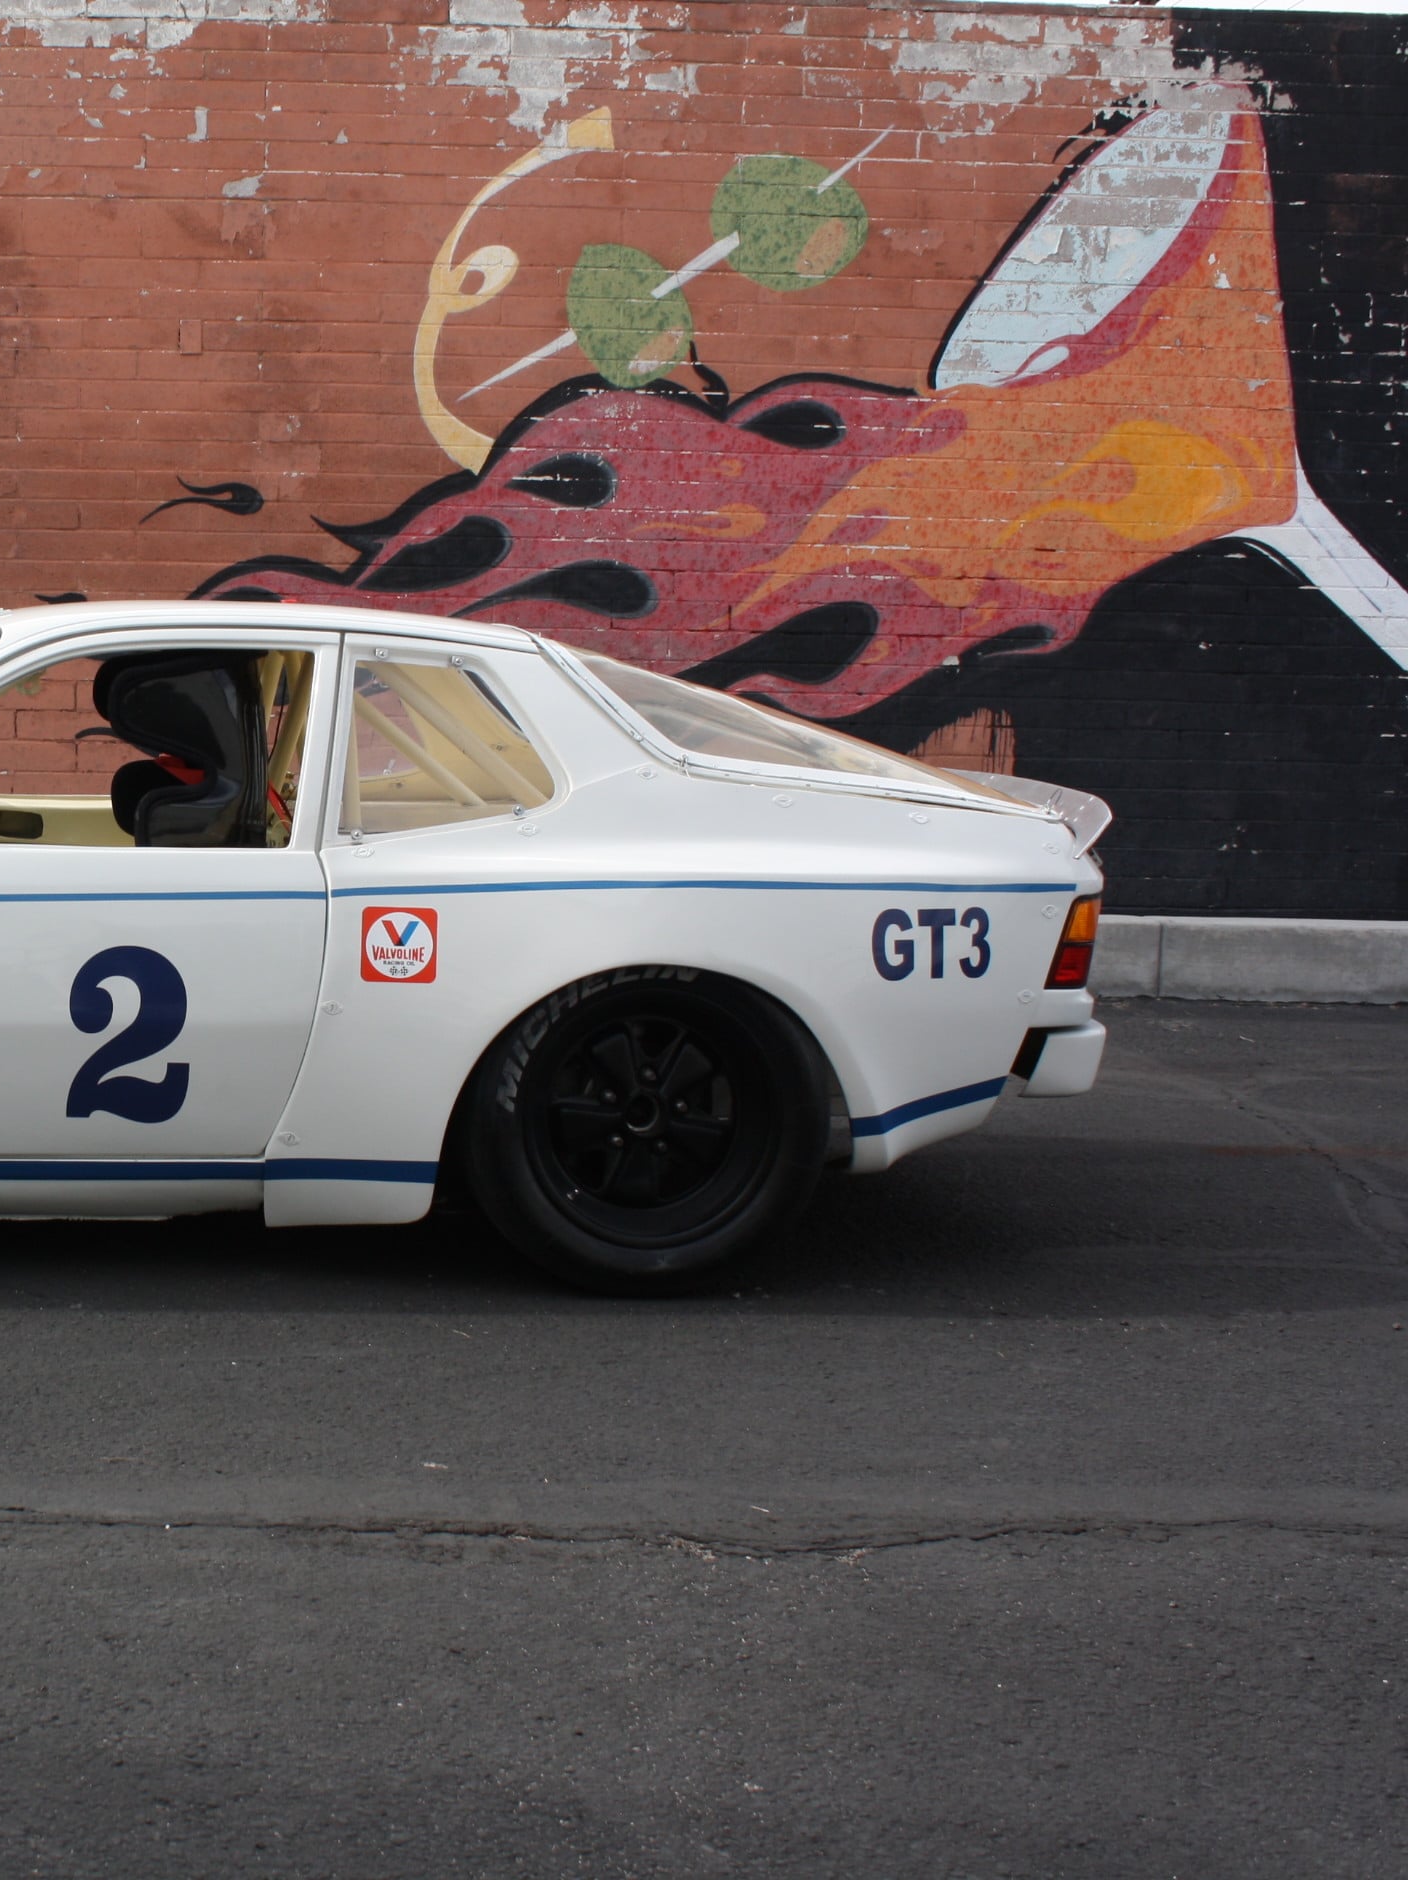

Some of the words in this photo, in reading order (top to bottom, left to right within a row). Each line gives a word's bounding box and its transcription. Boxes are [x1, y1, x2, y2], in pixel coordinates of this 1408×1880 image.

[371, 945, 425, 963] VALVOLINE
[871, 906, 992, 982] GT3
[66, 945, 191, 1125] 2
[496, 966, 702, 1113] MICHELIN
